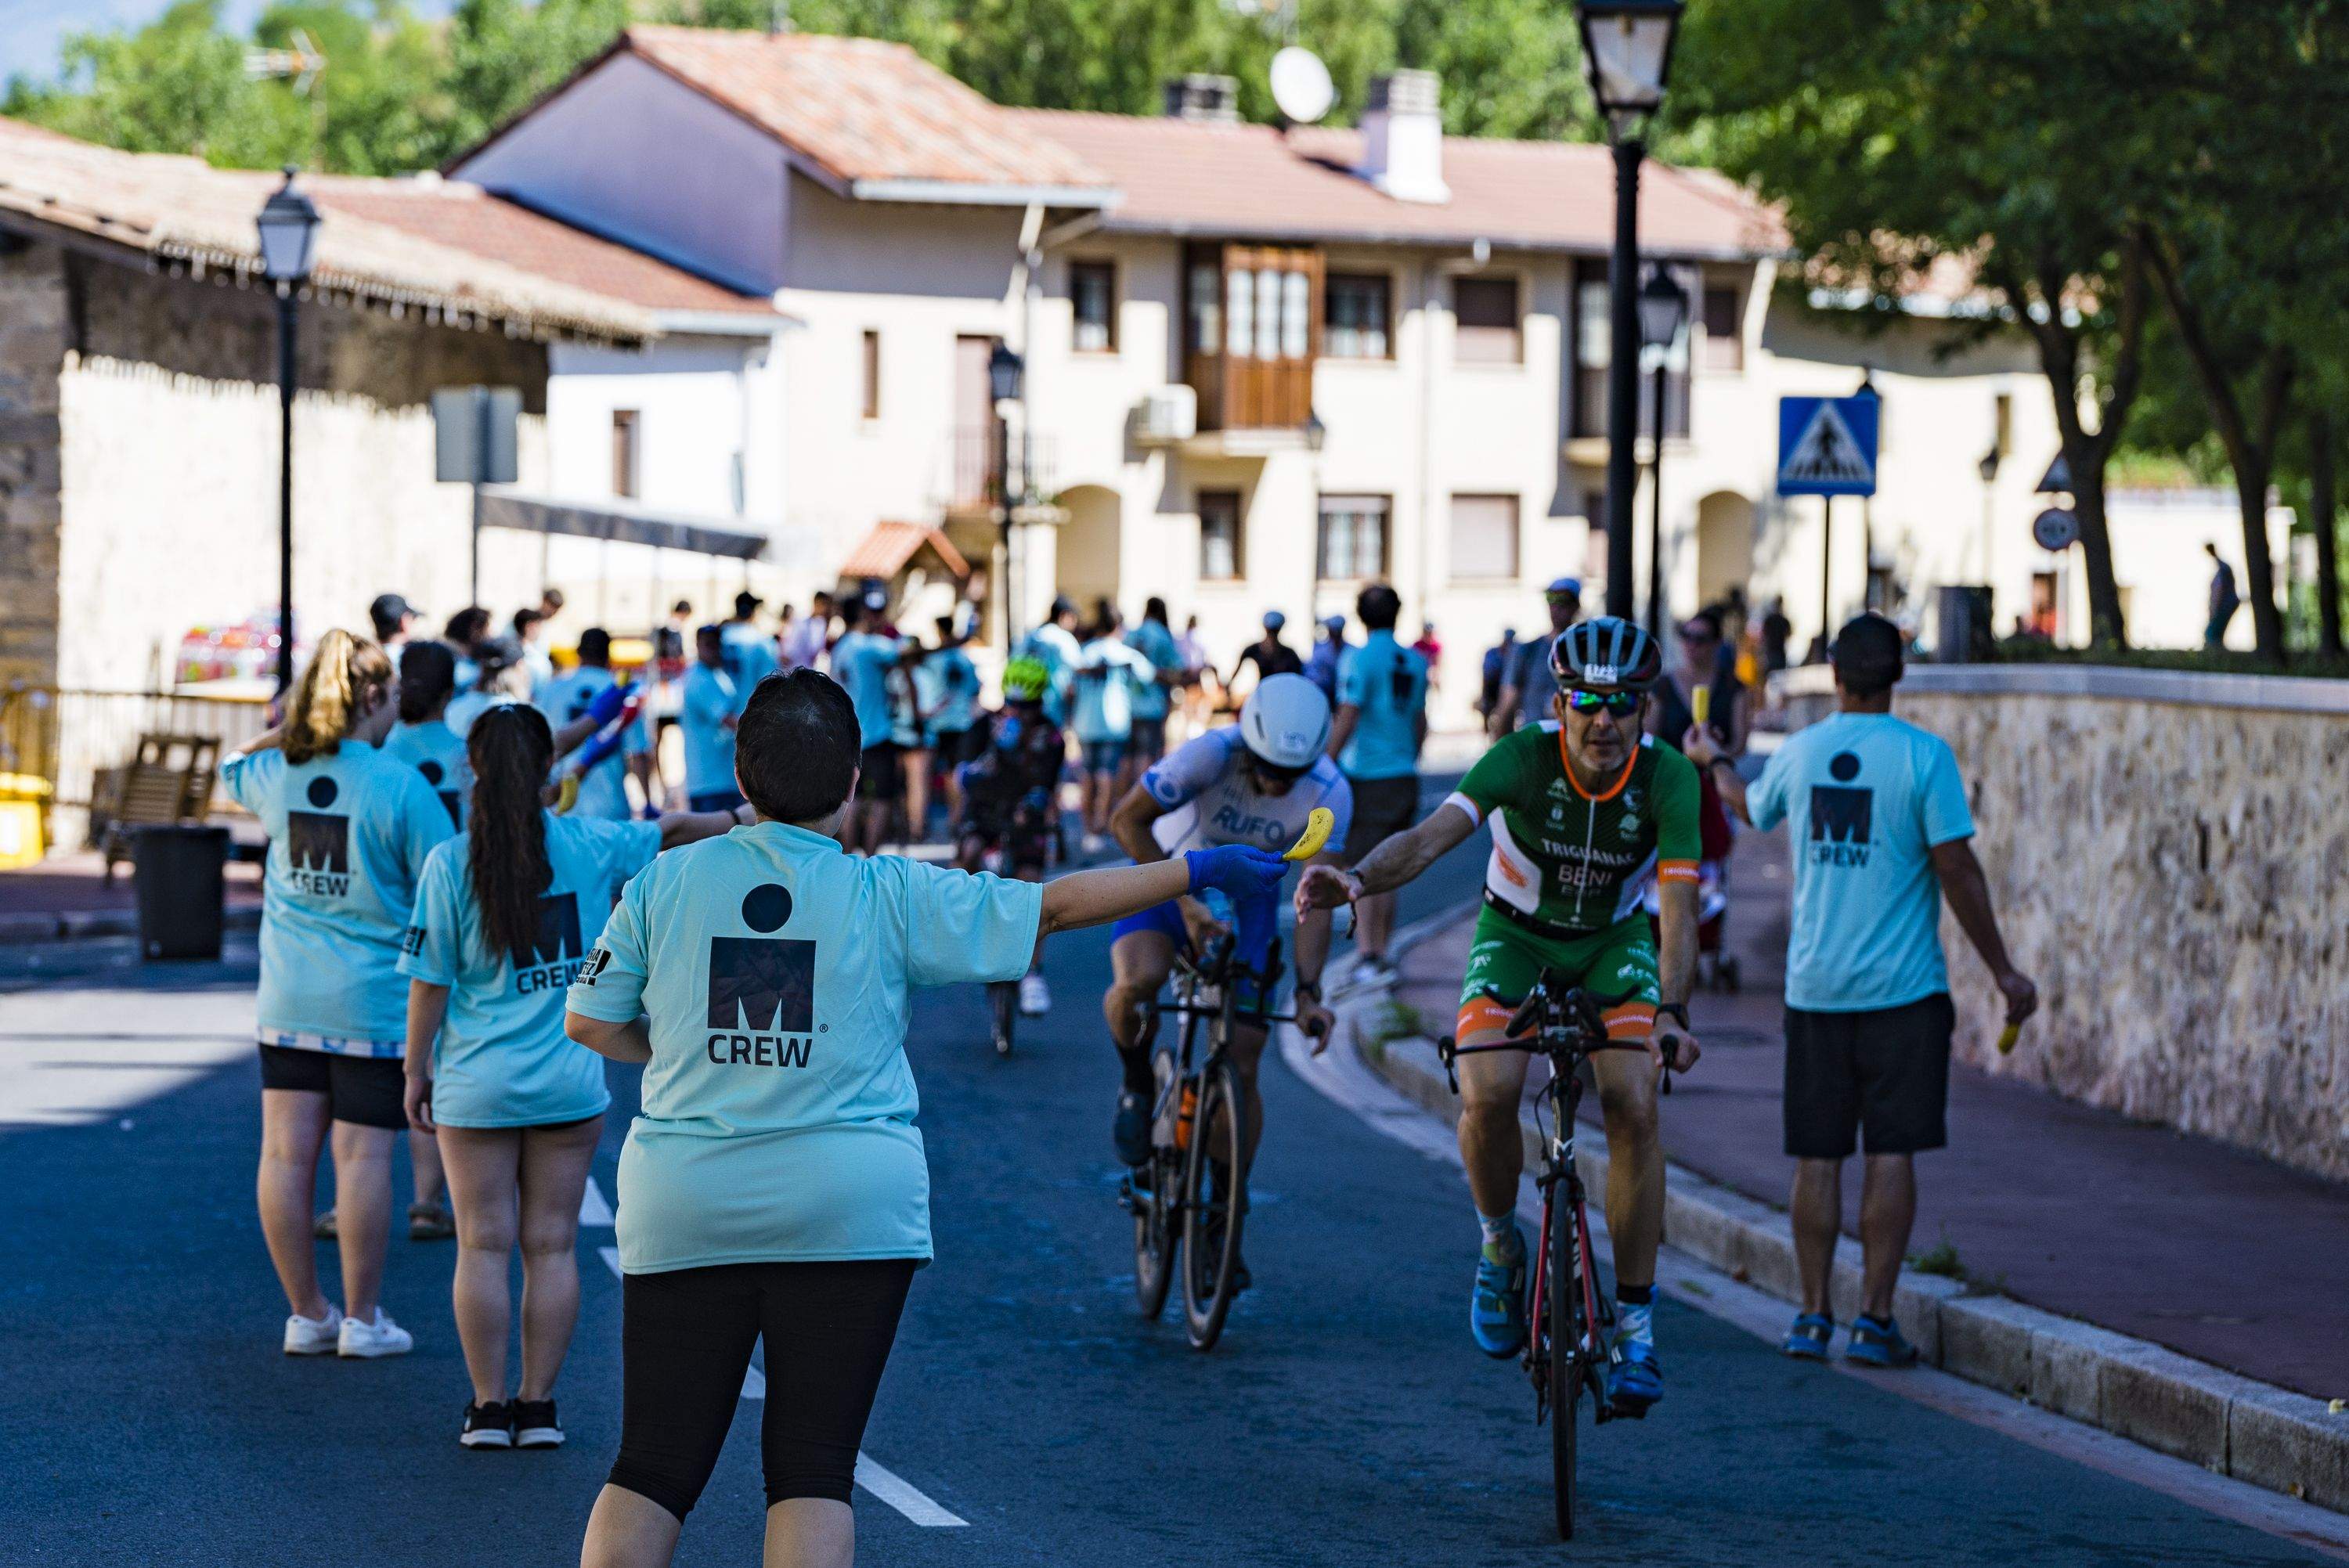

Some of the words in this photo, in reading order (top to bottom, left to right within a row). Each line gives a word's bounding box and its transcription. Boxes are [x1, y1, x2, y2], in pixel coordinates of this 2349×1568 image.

[1211, 805, 1286, 844] RUFO
[1810, 845, 1869, 867] CREW
[290, 871, 349, 897] CREW
[707, 1033, 813, 1069] CREW
